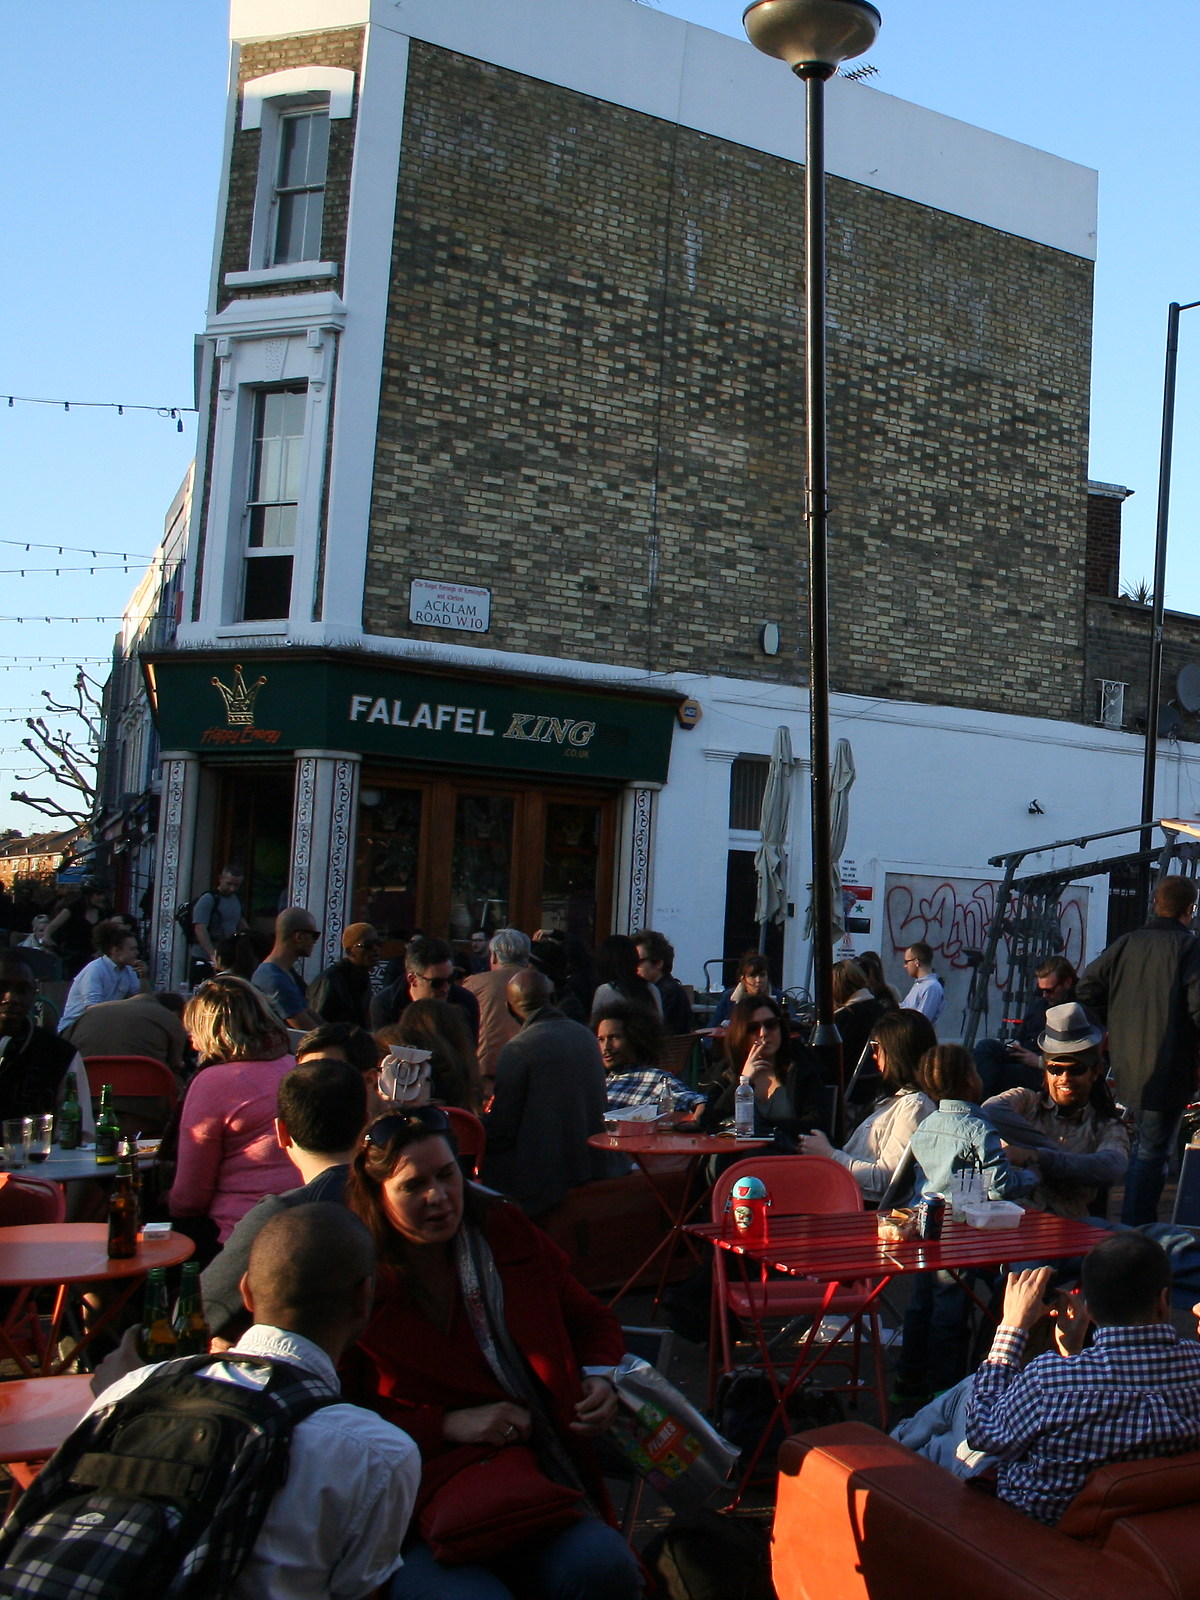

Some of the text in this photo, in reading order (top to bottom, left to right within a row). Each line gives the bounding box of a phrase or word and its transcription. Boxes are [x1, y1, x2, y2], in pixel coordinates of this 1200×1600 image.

[424, 600, 477, 616] ACKLAM
[349, 694, 596, 747] FALAFEL KING
[201, 726, 282, 744] Happy Energy
